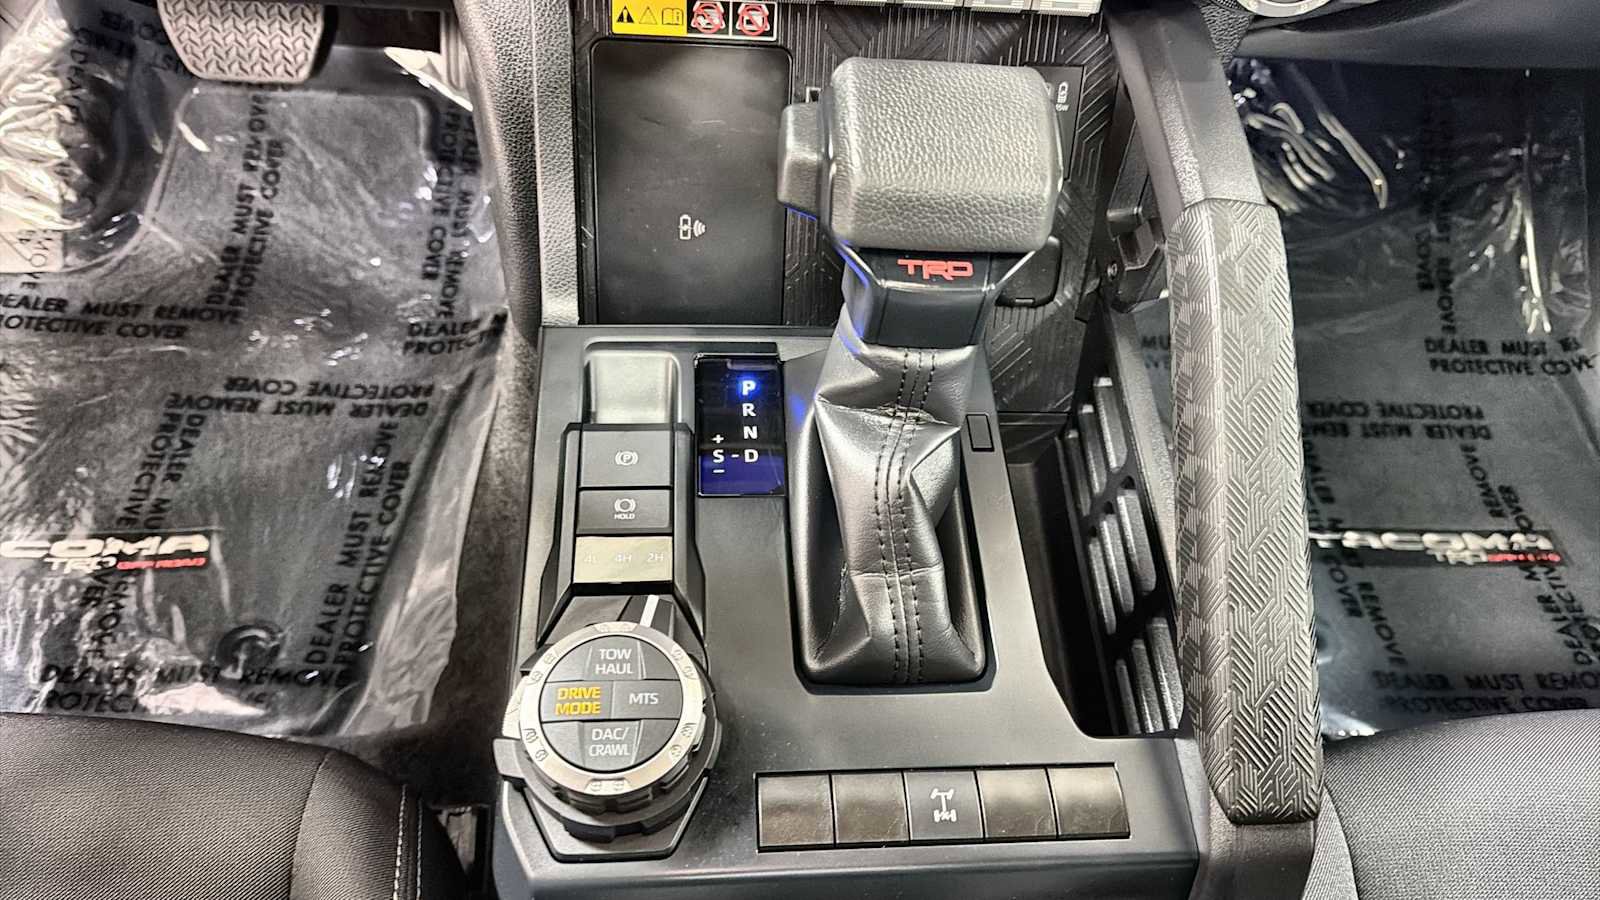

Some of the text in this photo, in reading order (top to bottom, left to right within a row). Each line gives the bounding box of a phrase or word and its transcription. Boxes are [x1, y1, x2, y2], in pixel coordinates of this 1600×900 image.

[228, 139, 285, 307] PROTECTIVE COVER
[206, 246, 240, 305] DEALER
[232, 183, 256, 234] MUST
[422, 227, 446, 280] COVER
[897, 258, 974, 281] TRD
[81, 301, 144, 318] MUST
[153, 304, 243, 325] REMOVE
[117, 323, 188, 340] COVER
[1424, 337, 1489, 354] DEALER
[1501, 340, 1547, 356] MUST
[1430, 358, 1535, 375] PROTECTIVE
[224, 376, 436, 400] PROTECTIVE COVER
[742, 379, 757, 395] P
[167, 393, 429, 418] DEALER MUST REMOVE
[742, 402, 757, 417] R
[1305, 401, 1485, 420] PROTECTIVE COVER
[743, 425, 758, 439] N
[1360, 423, 1413, 438] MUST
[1423, 423, 1493, 440] DEALER
[162, 413, 207, 482] DEALER
[712, 449, 725, 463] S
[744, 449, 759, 463] D
[116, 412, 183, 526] PROTECTIVE
[1460, 444, 1508, 519] REMOVE
[44, 556, 117, 575] TRD
[333, 460, 412, 667] PROTECTIVE COVER
[614, 551, 633, 563] 4H
[647, 551, 664, 563] 2H
[303, 582, 350, 666] DEALER
[336, 511, 373, 568] MUST
[1357, 582, 1407, 665] REMOVE
[1537, 595, 1592, 666] DEALER
[599, 648, 632, 660] TOW
[155, 662, 222, 683] MUST
[239, 666, 353, 687] REMOVE
[595, 661, 633, 675] HAUL
[1464, 673, 1524, 690] MUST
[557, 686, 601, 700] DRIVE
[629, 693, 659, 705] MTS
[555, 701, 601, 716] MODE
[592, 727, 630, 741] DAC/
[589, 743, 630, 757] CRAWL
